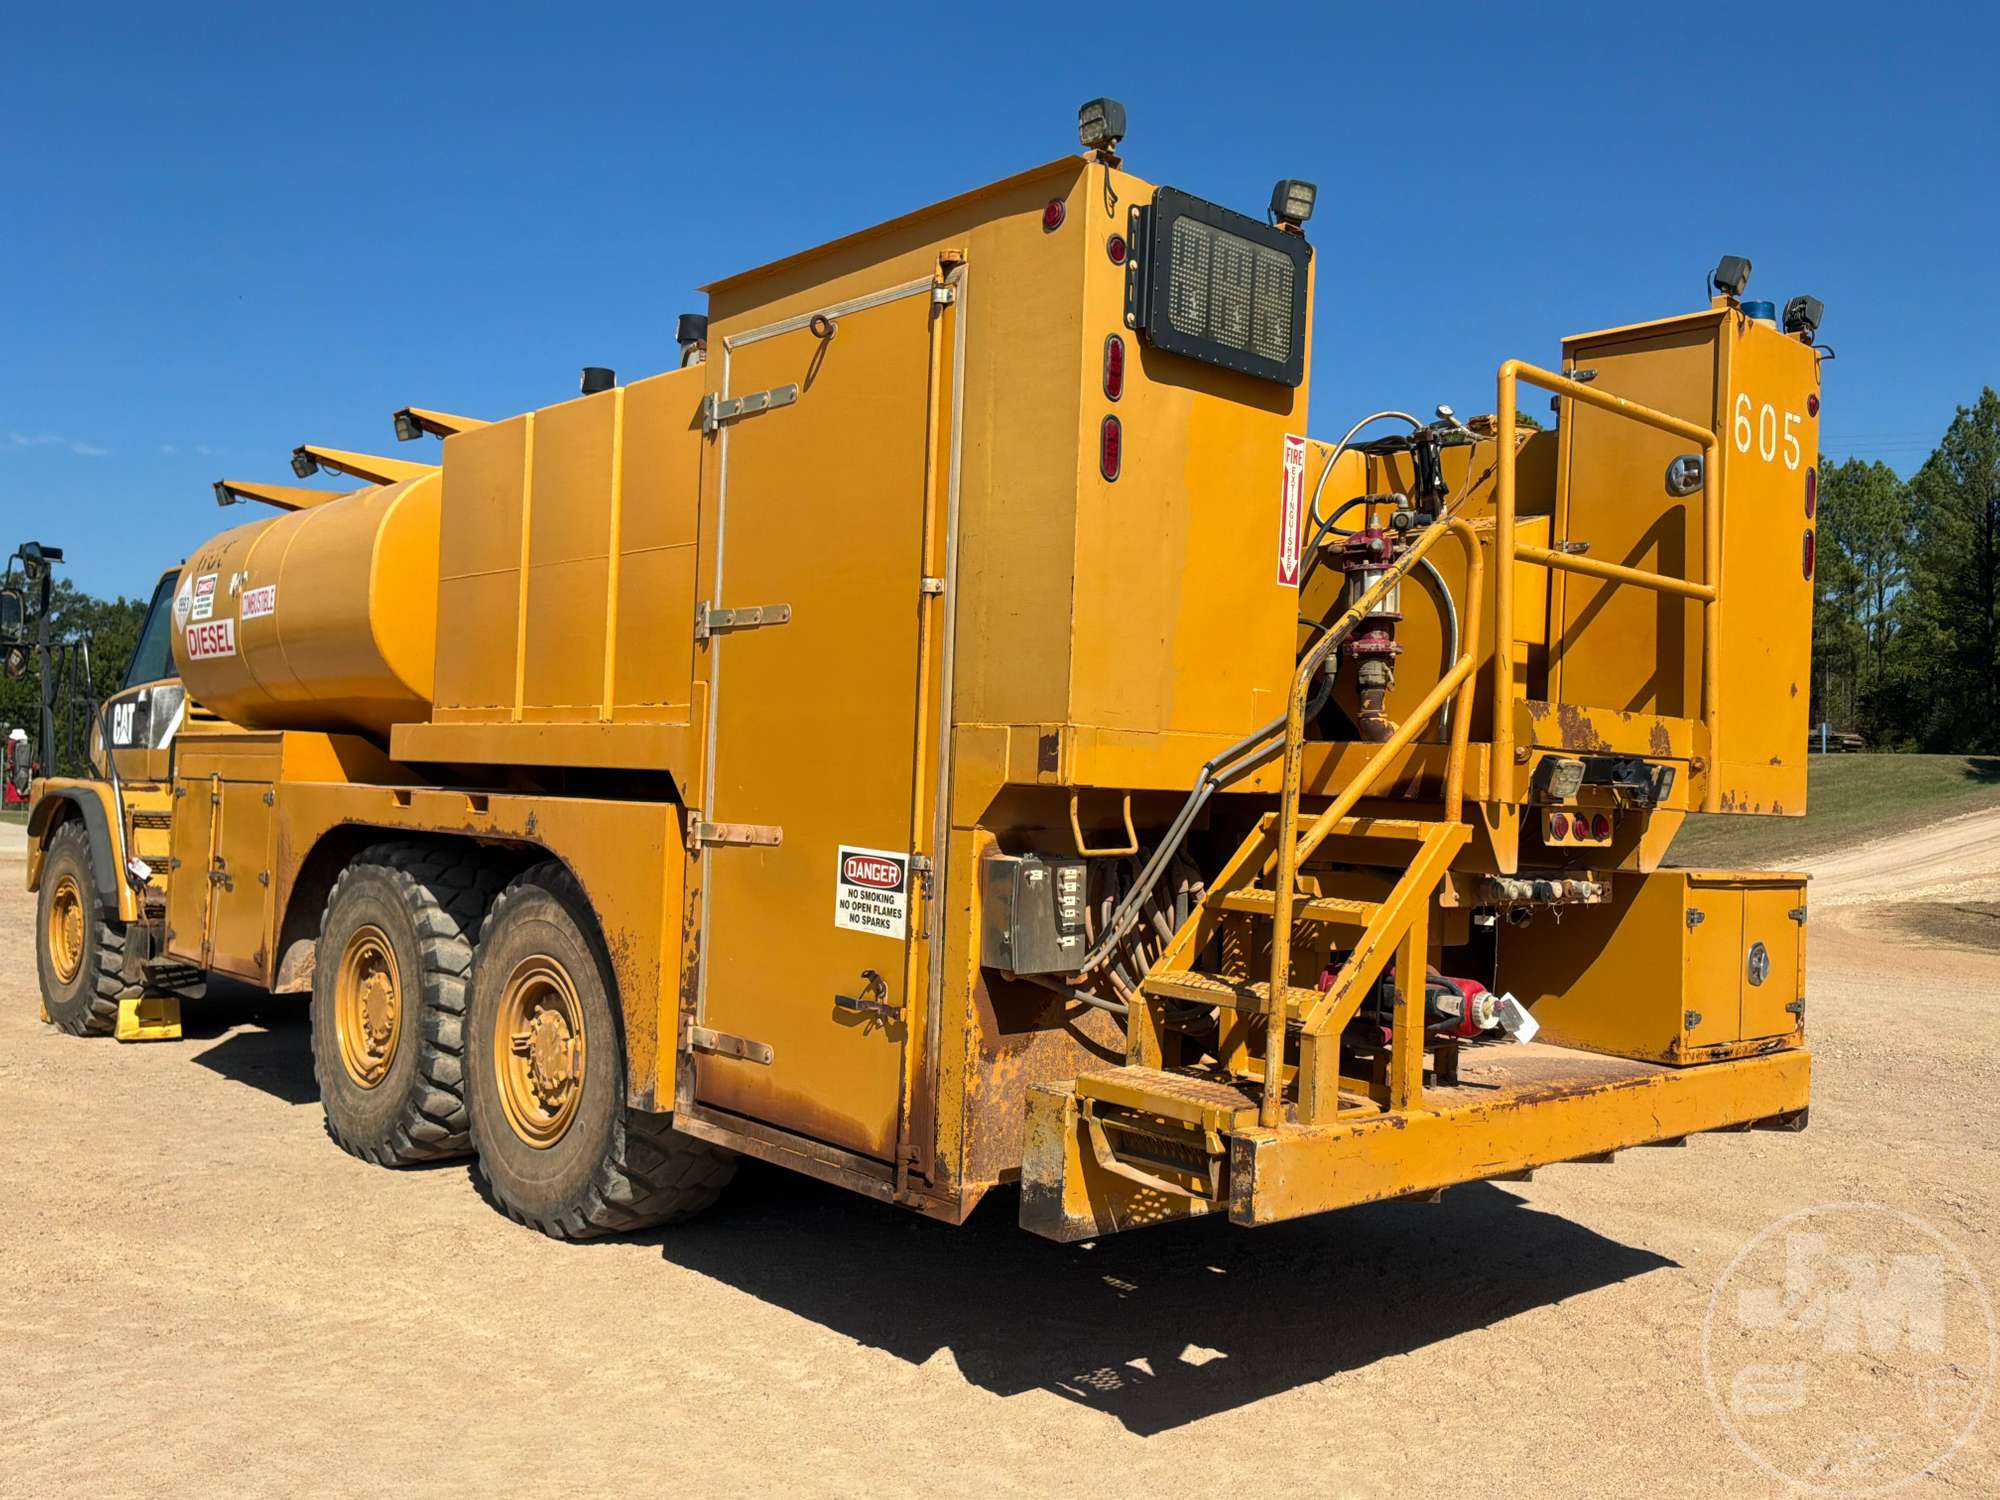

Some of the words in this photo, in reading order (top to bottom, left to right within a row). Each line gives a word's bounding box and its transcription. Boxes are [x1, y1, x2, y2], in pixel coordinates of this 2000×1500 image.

[1735, 392, 1801, 471] 605
[1286, 447, 1303, 466] FIRE
[1287, 466, 1296, 572] EXTINGUISHER
[188, 624, 233, 656] DIESEL
[113, 703, 136, 745] CAT
[848, 861, 898, 883] DANGER
[848, 889, 858, 898] NO
[860, 890, 895, 904] SMOKING
[840, 899, 850, 909] NO
[852, 902, 871, 913] OPEN
[873, 905, 902, 918] FLAMES
[849, 913, 860, 923] NO
[861, 915, 891, 929] SPARKS
